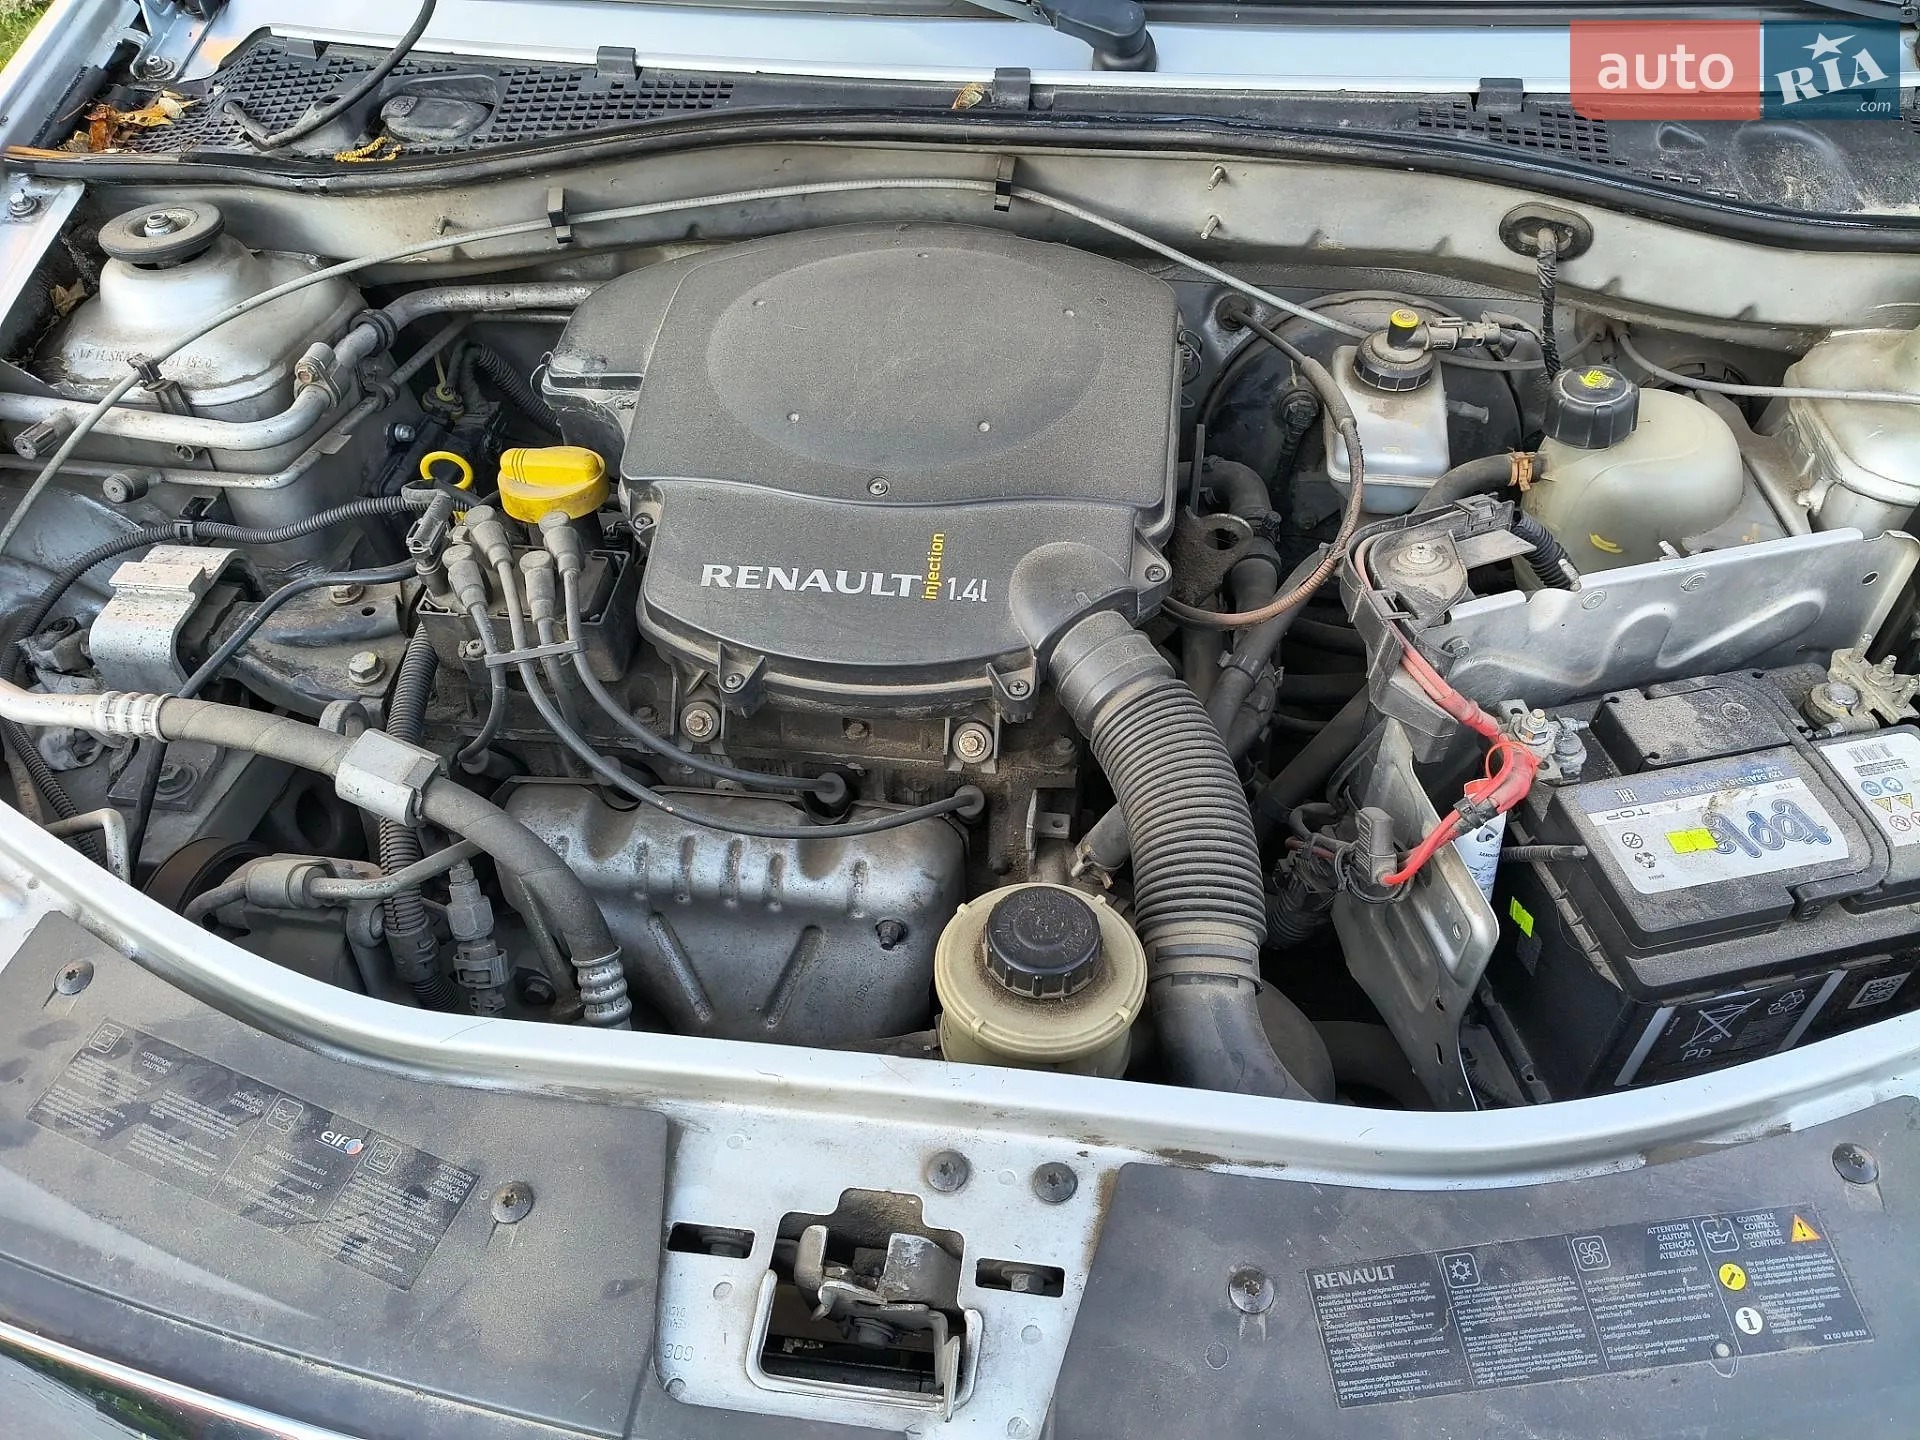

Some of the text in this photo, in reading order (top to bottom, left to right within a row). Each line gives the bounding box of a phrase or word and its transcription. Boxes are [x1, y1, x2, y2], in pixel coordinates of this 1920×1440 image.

[921, 532, 945, 600] injection
[700, 564, 922, 597] RENAULT
[1606, 809, 1650, 821] TOP
[1682, 1048, 1713, 1062] Pb
[1645, 1222, 1689, 1234] ATTENTION
[1743, 1220, 1779, 1231] CONTROL
[1656, 1231, 1692, 1242] CAUTION
[1749, 1237, 1786, 1248] CONTROL
[1657, 1238, 1696, 1252] ATENÇÃO
[1312, 1264, 1398, 1289] RENAULT
